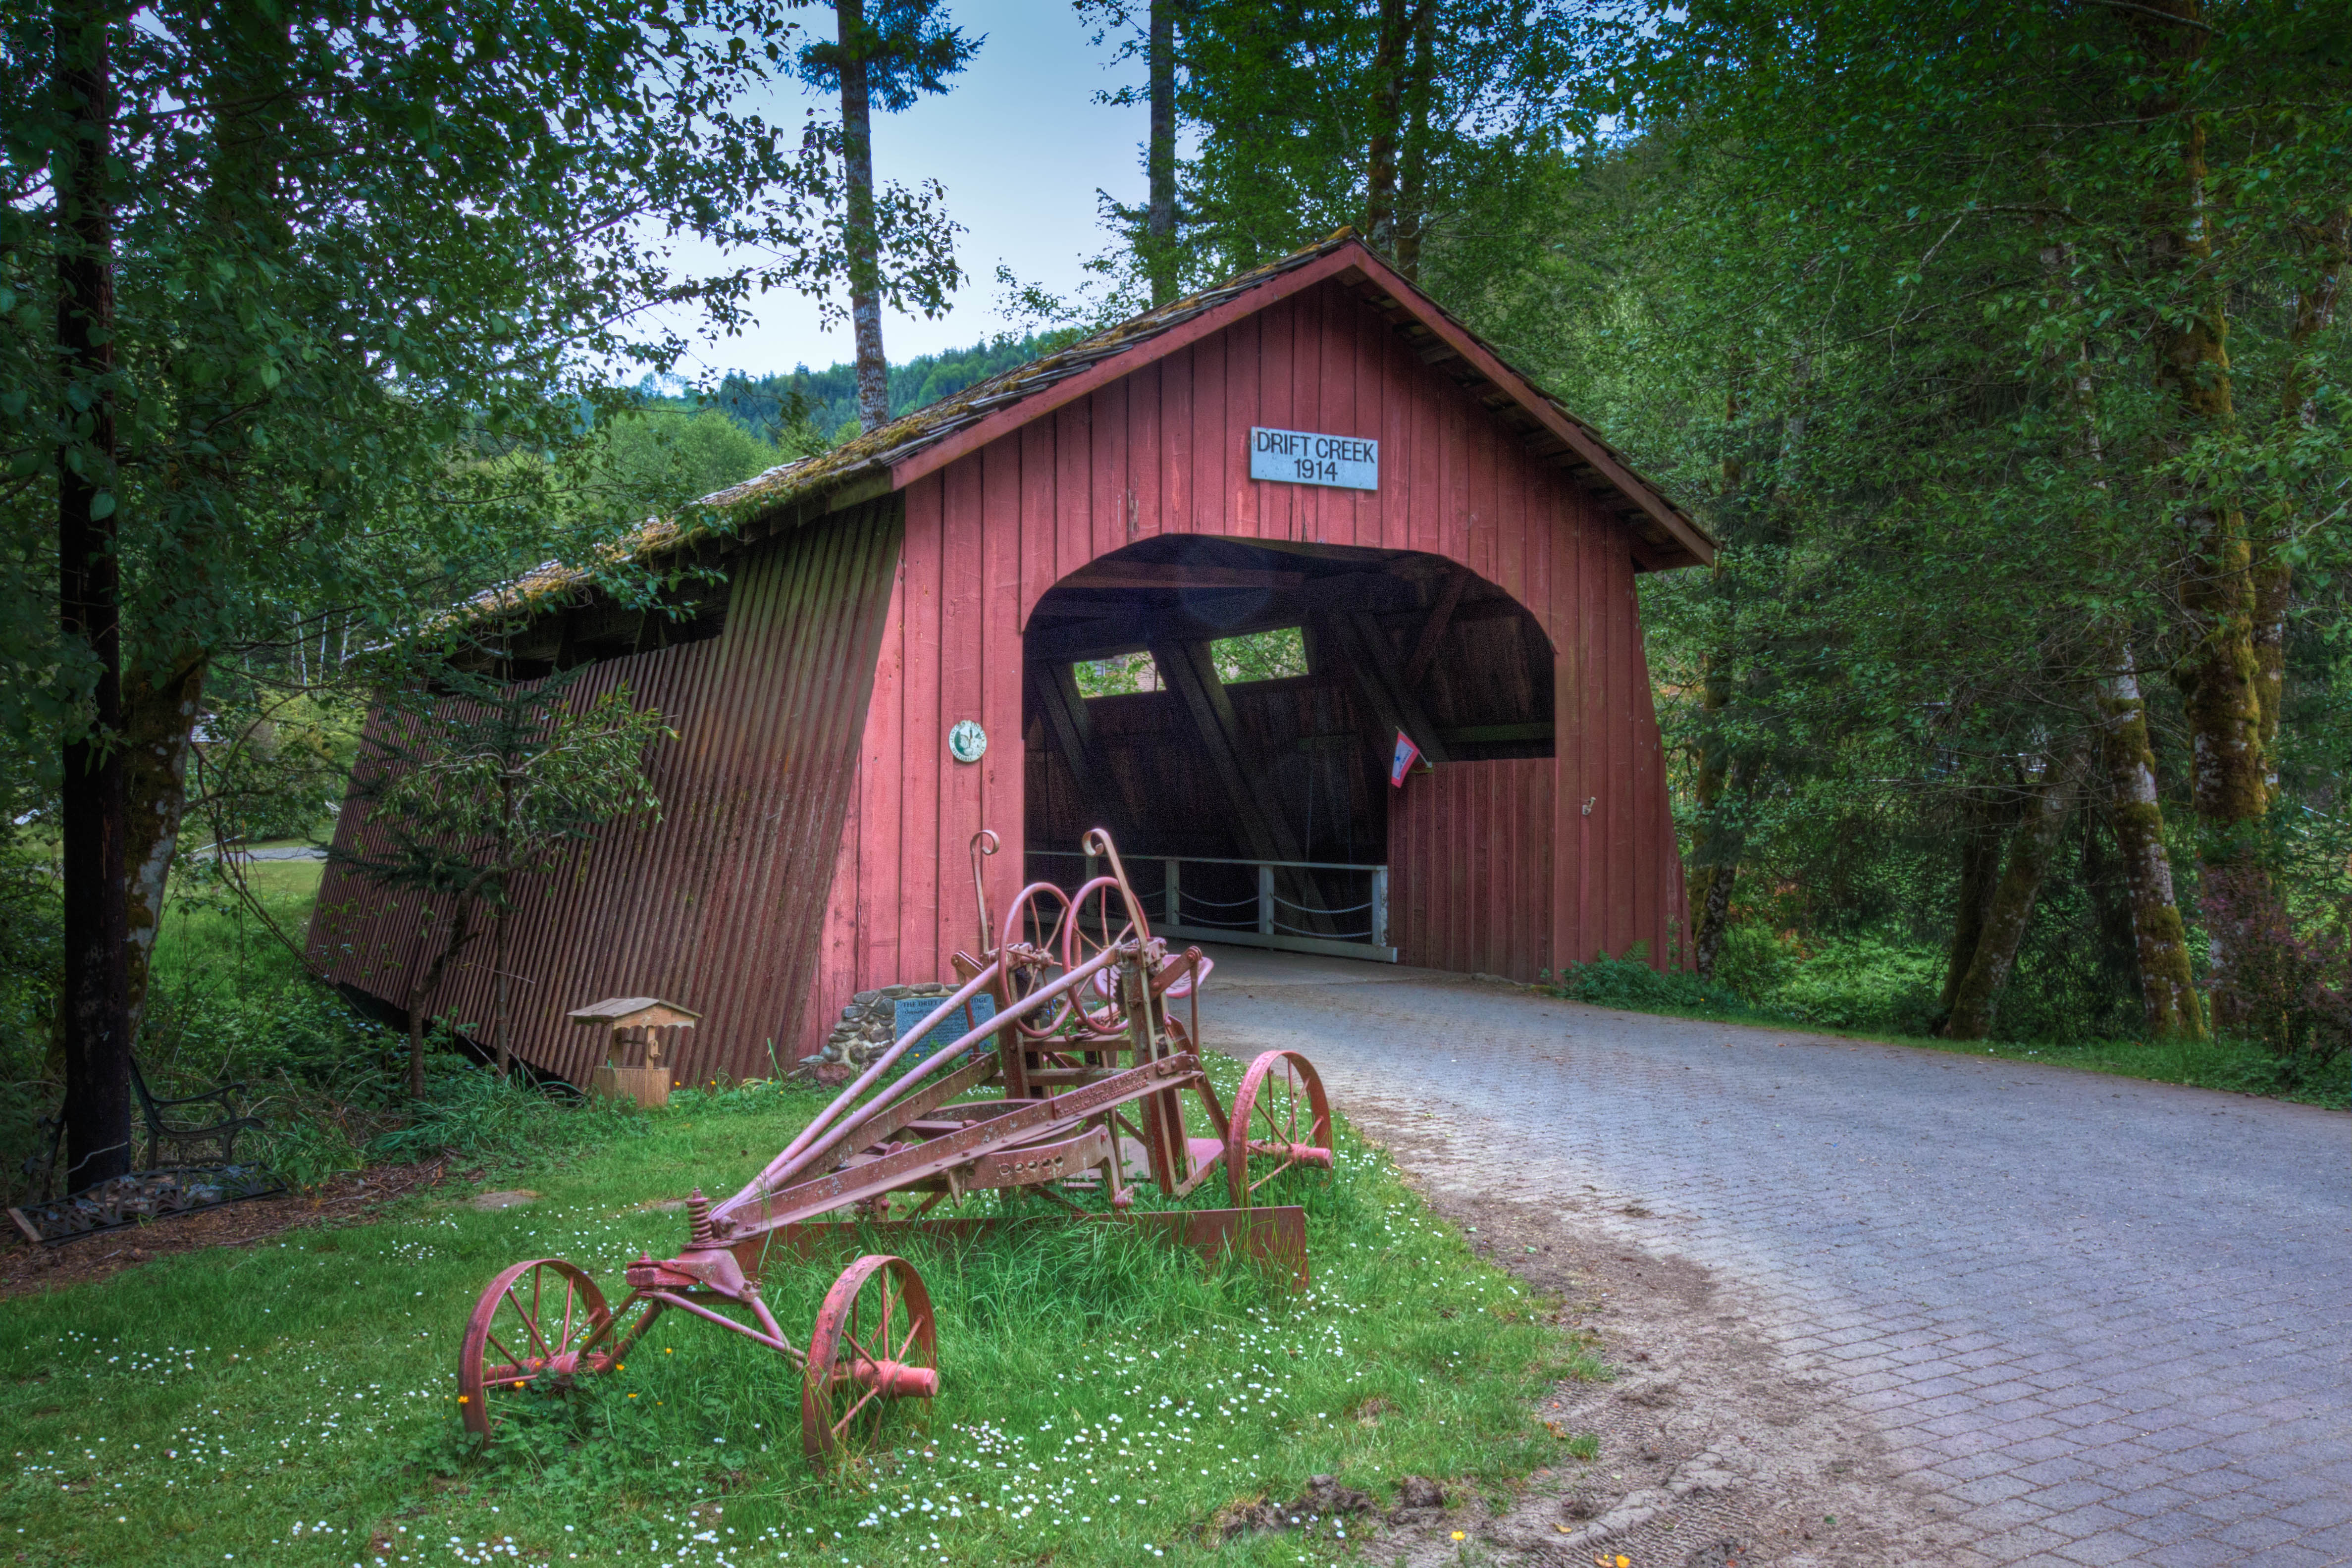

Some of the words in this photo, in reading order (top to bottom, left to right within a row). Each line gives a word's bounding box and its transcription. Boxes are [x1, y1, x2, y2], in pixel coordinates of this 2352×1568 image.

[1257, 431, 1311, 457] DRIFT
[1315, 438, 1375, 464] CREEK
[1294, 458, 1338, 481] 1914
[950, 722, 966, 740] LINCOLN
[970, 722, 985, 738] COUNTY
[952, 747, 972, 761] HISTORIC
